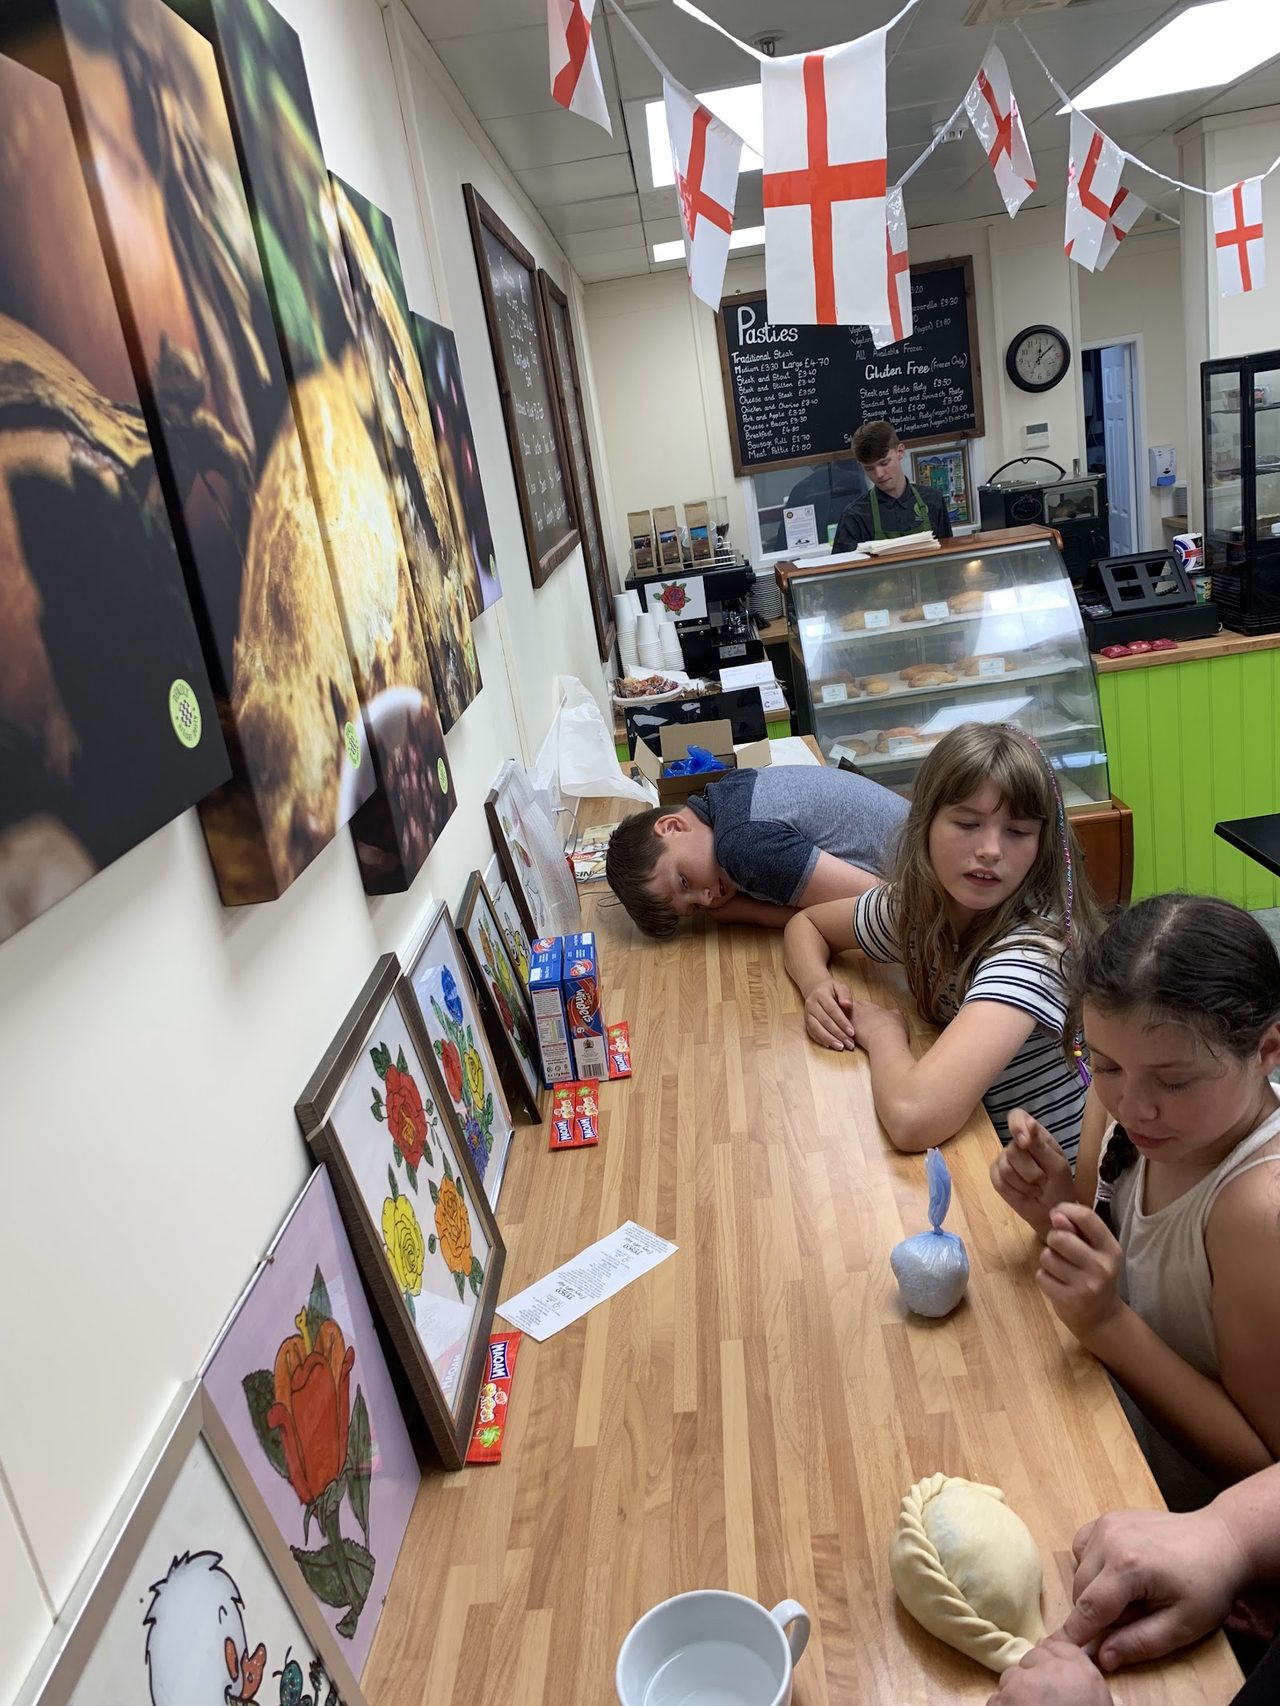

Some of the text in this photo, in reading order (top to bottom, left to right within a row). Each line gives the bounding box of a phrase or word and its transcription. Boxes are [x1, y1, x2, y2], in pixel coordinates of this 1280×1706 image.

[737, 305, 799, 346] Pasties
[903, 342, 923, 354] Frozen
[731, 349, 794, 364] Traditional Steak
[734, 364, 759, 374] Medium
[782, 360, 803, 372] Large
[865, 363, 902, 380] Gluten
[906, 360, 931, 375] Free
[736, 375, 755, 386] Steak
[757, 375, 770, 383] and
[772, 371, 791, 381] Stout
[738, 386, 754, 396] Steak
[757, 384, 769, 392] and
[772, 381, 793, 390] Stilton
[860, 387, 878, 399] Steak
[878, 388, 890, 397] and
[892, 385, 910, 395] Potato
[912, 382, 927, 393] Pasty
[739, 395, 762, 405] Cheese
[778, 391, 793, 399] Steak
[909, 394, 920, 402] and
[741, 405, 762, 414] Chicken
[764, 403, 776, 412] and
[862, 408, 888, 419] Sausage
[755, 413, 767, 421] and
[769, 411, 785, 420] Apple
[743, 424, 765, 432] Cheese
[770, 420, 789, 428] Bacon
[745, 430, 774, 440] Breakfast
[747, 439, 772, 450] Sausage
[774, 437, 788, 445] Roll
[748, 448, 767, 460] Meat
[622, 1244, 643, 1256] TESCO
[555, 1287, 575, 1301] TESCO
[491, 1343, 506, 1378] MAOAM
